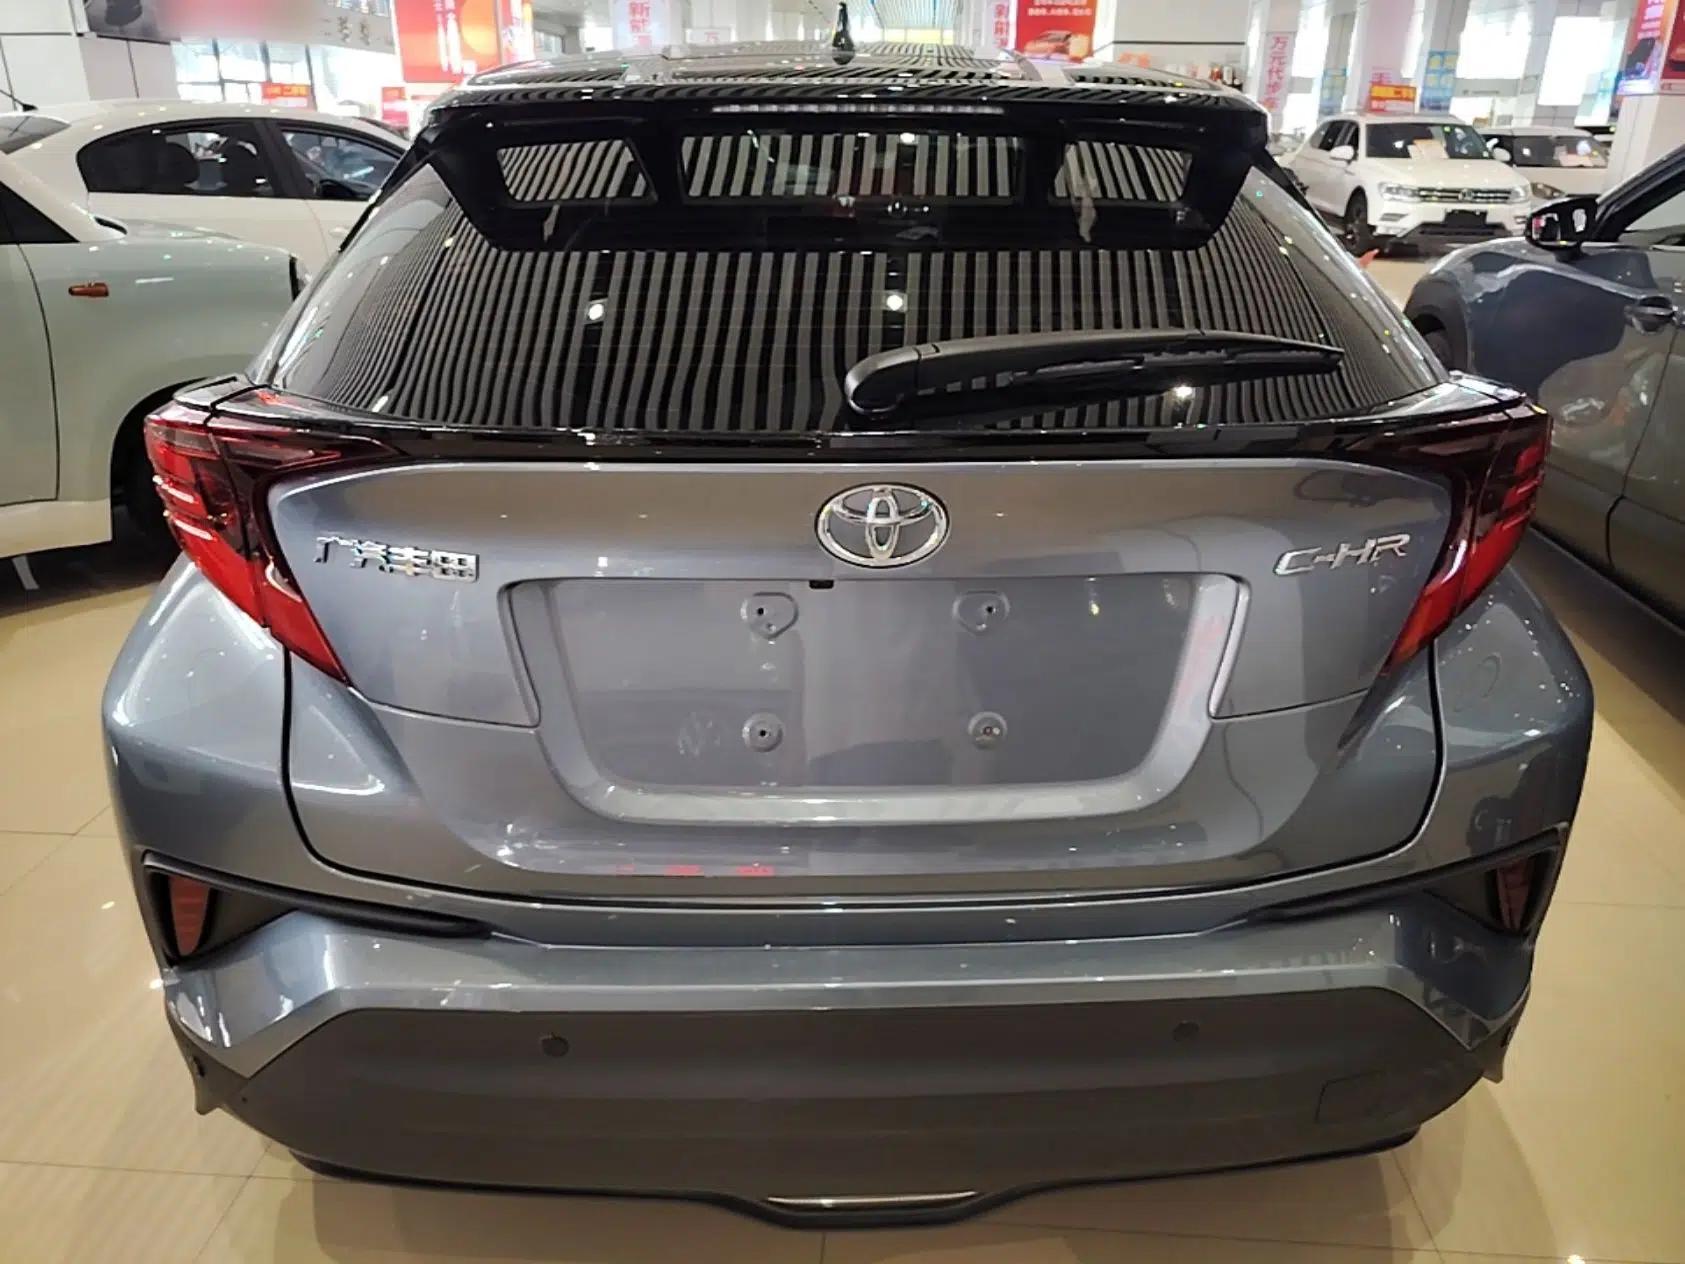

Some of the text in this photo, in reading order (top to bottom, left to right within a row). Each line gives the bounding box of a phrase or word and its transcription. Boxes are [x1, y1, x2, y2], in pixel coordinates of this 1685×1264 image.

[315, 536, 479, 583] 广汽丰田
[1274, 533, 1411, 575] C-HR
